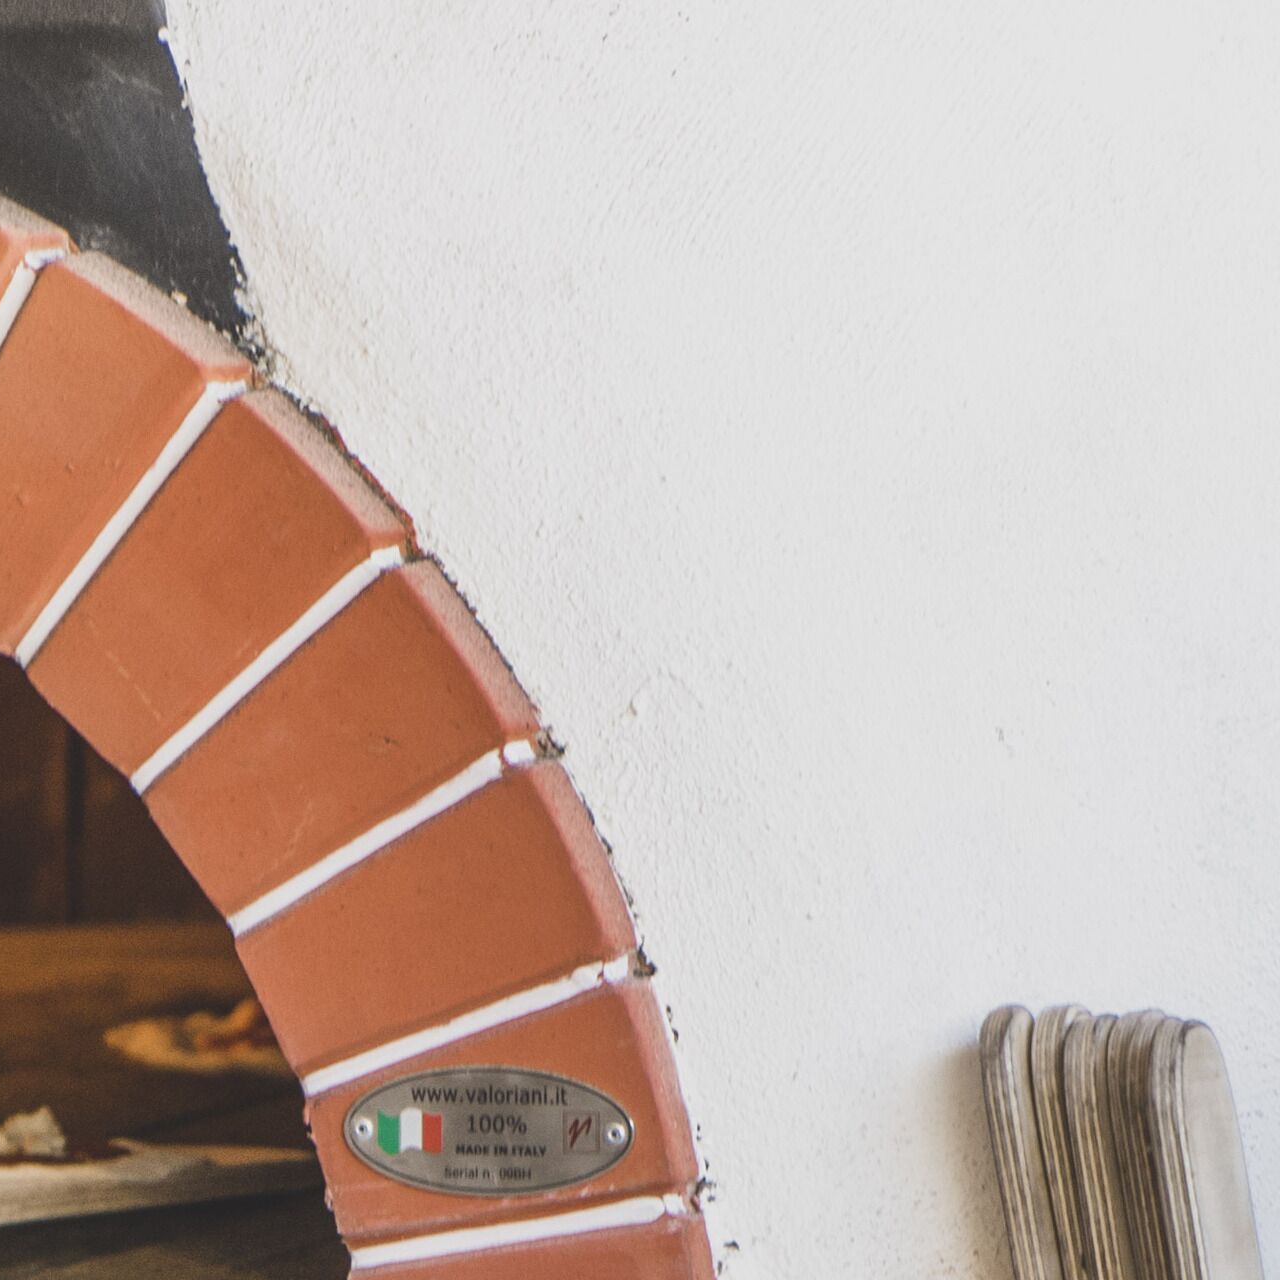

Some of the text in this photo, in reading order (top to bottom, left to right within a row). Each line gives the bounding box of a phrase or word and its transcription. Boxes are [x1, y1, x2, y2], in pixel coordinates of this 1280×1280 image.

[411, 1085, 568, 1106] www.valoriani.it
[468, 1114, 527, 1135] 100%
[455, 1144, 547, 1158] MADE IN ITALY
